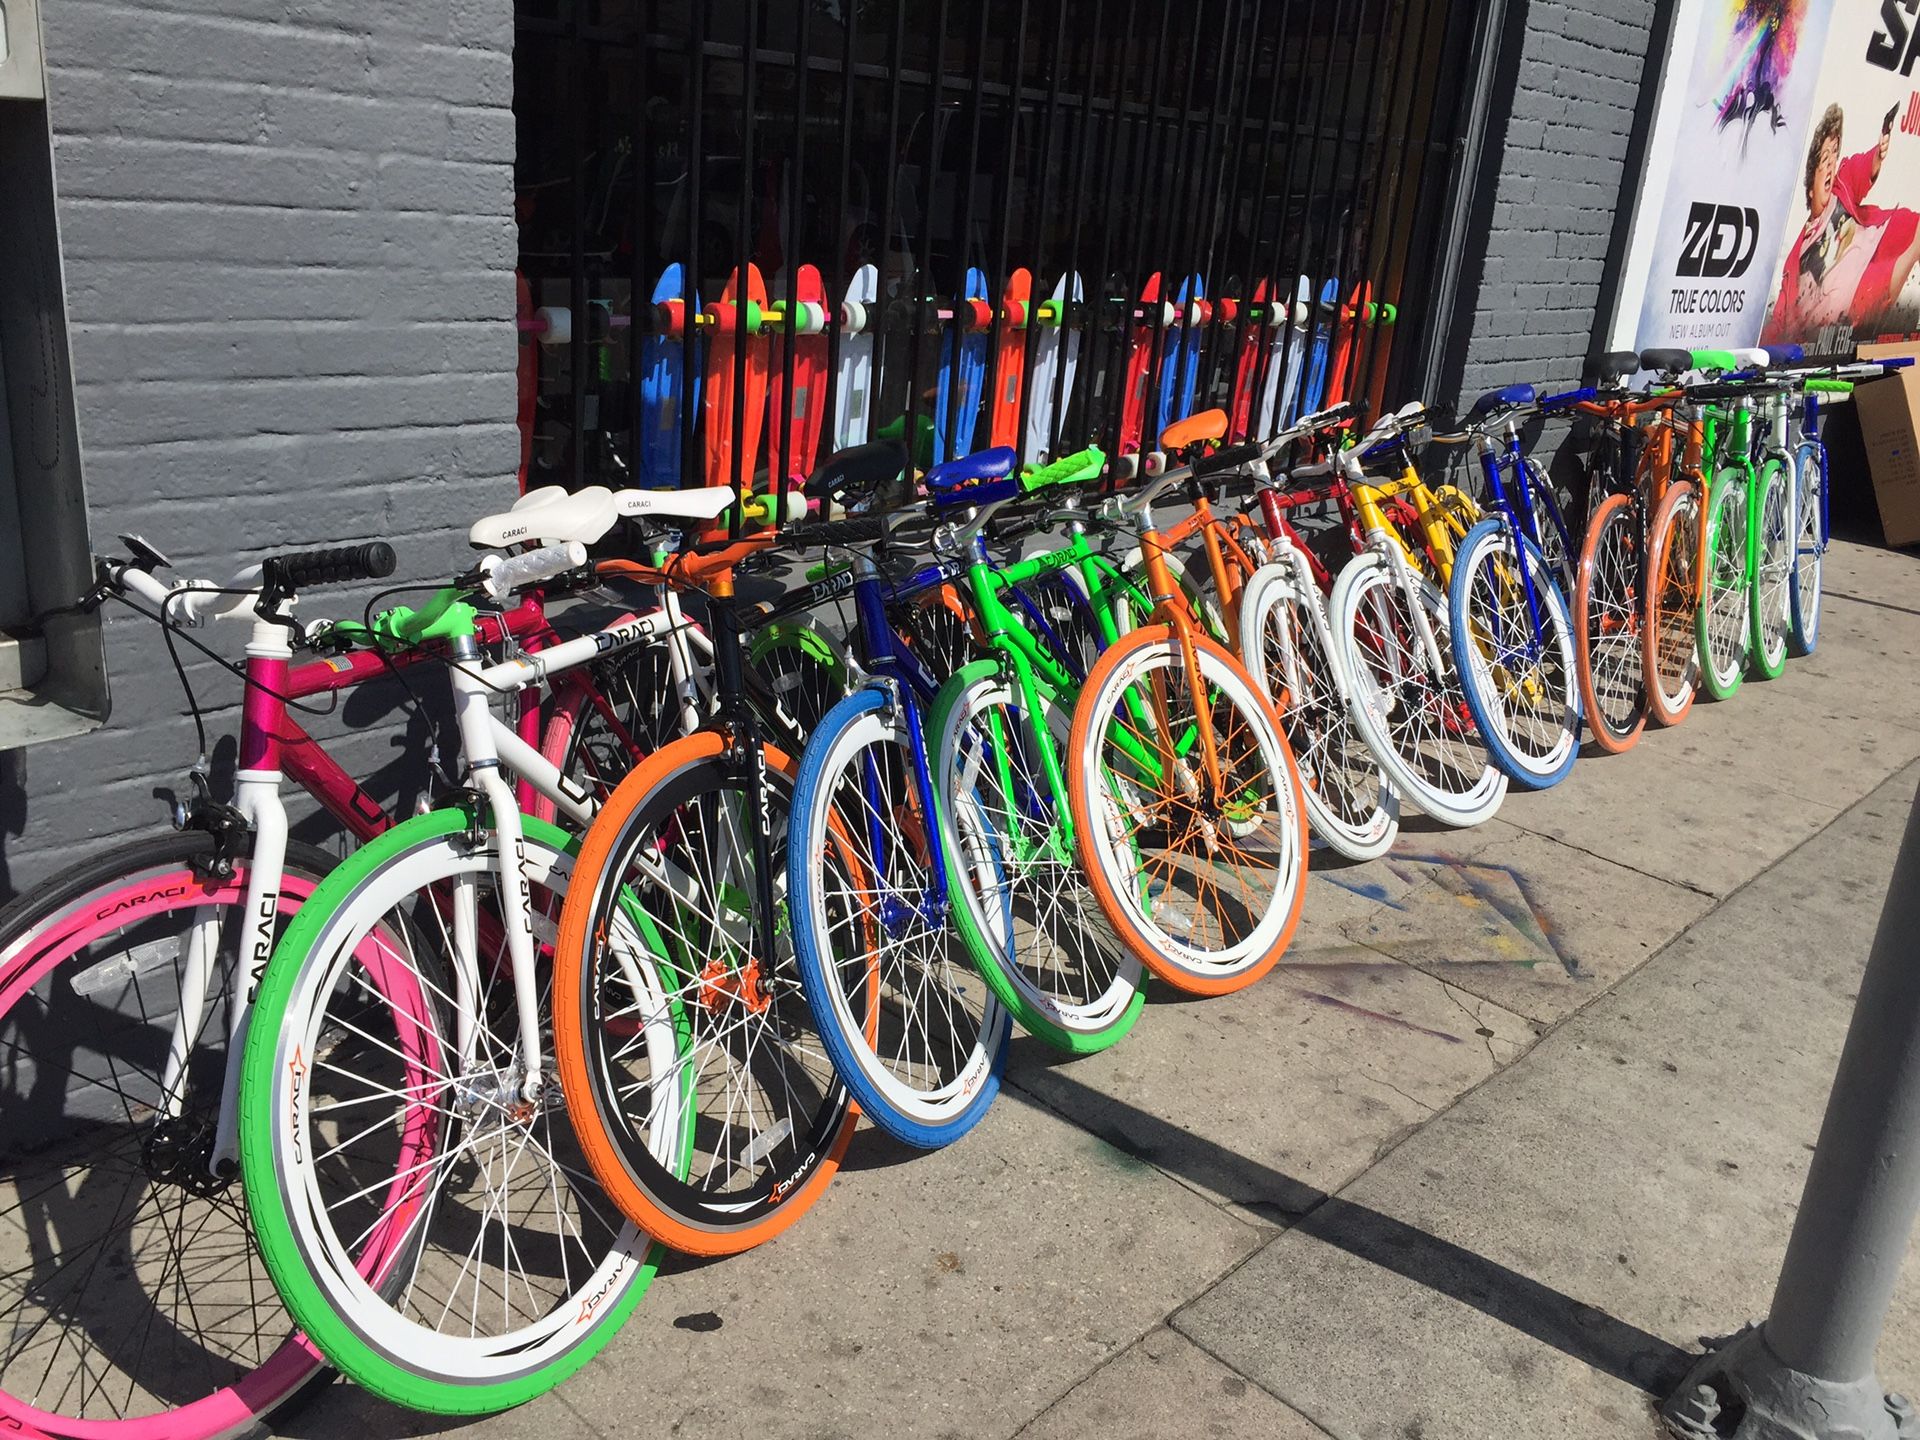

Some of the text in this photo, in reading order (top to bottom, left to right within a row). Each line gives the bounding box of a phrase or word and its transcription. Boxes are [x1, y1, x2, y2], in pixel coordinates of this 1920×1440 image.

[1901, 90, 1920, 137] JU
[1669, 288, 1746, 314] TRUE COLORS
[1669, 322, 1731, 340] NEW ALBUM OUT
[627, 500, 652, 508] CARACI
[502, 526, 528, 539] CARACI
[1311, 583, 1331, 631] CARACI
[595, 618, 655, 653] CARACI
[1189, 634, 1205, 696] CARACI
[1106, 669, 1131, 705] CARACI
[757, 749, 771, 836] CARACI
[96, 886, 185, 921] CARACI
[515, 837, 533, 934] CARACI
[247, 892, 277, 1006] CARACI
[1168, 943, 1203, 964] CARACI
[594, 939, 604, 1020] CARACI
[967, 1049, 989, 1088] CARACI
[293, 1071, 303, 1165] CARACI
[778, 1151, 816, 1194] CARACI
[588, 1250, 632, 1310] CARACI
